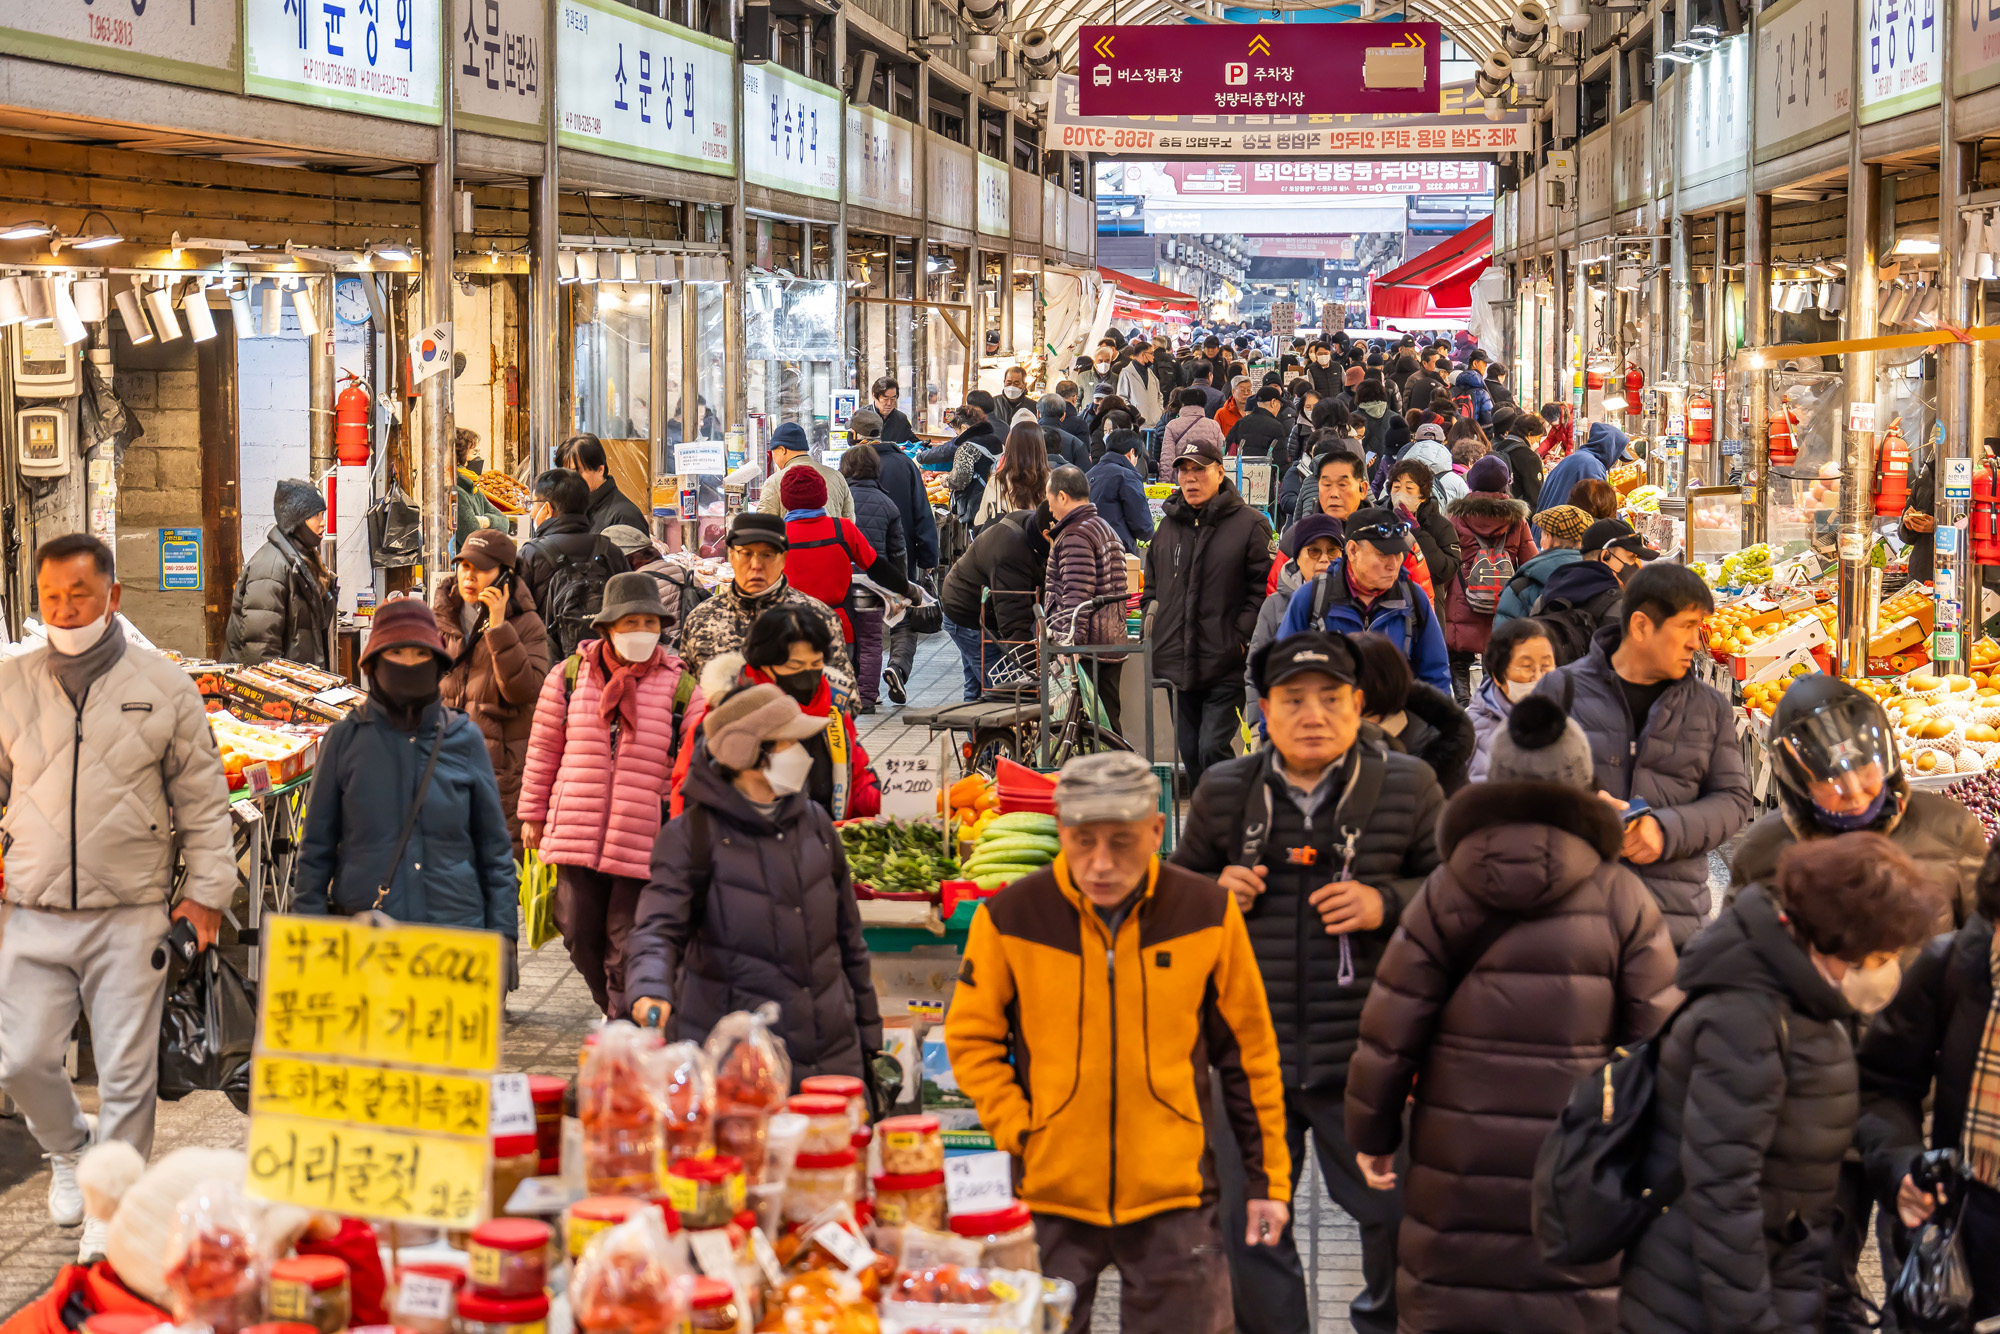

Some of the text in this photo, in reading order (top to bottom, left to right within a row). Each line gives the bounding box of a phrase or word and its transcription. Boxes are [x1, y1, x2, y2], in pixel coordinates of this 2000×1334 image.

[88, 13, 133, 46] T.963-5813
[614, 43, 695, 134] 소문상회
[1117, 67, 1183, 84] 버스정류장
[1230, 65, 1244, 83] P
[1253, 67, 1295, 82] 주차장
[1774, 10, 1828, 119] 강오상회
[1214, 91, 1306, 108] 청량리종합시장
[770, 94, 818, 166] 화승청과
[384, 994, 489, 1062] 가리비
[250, 1129, 421, 1213] 어리굴젓
